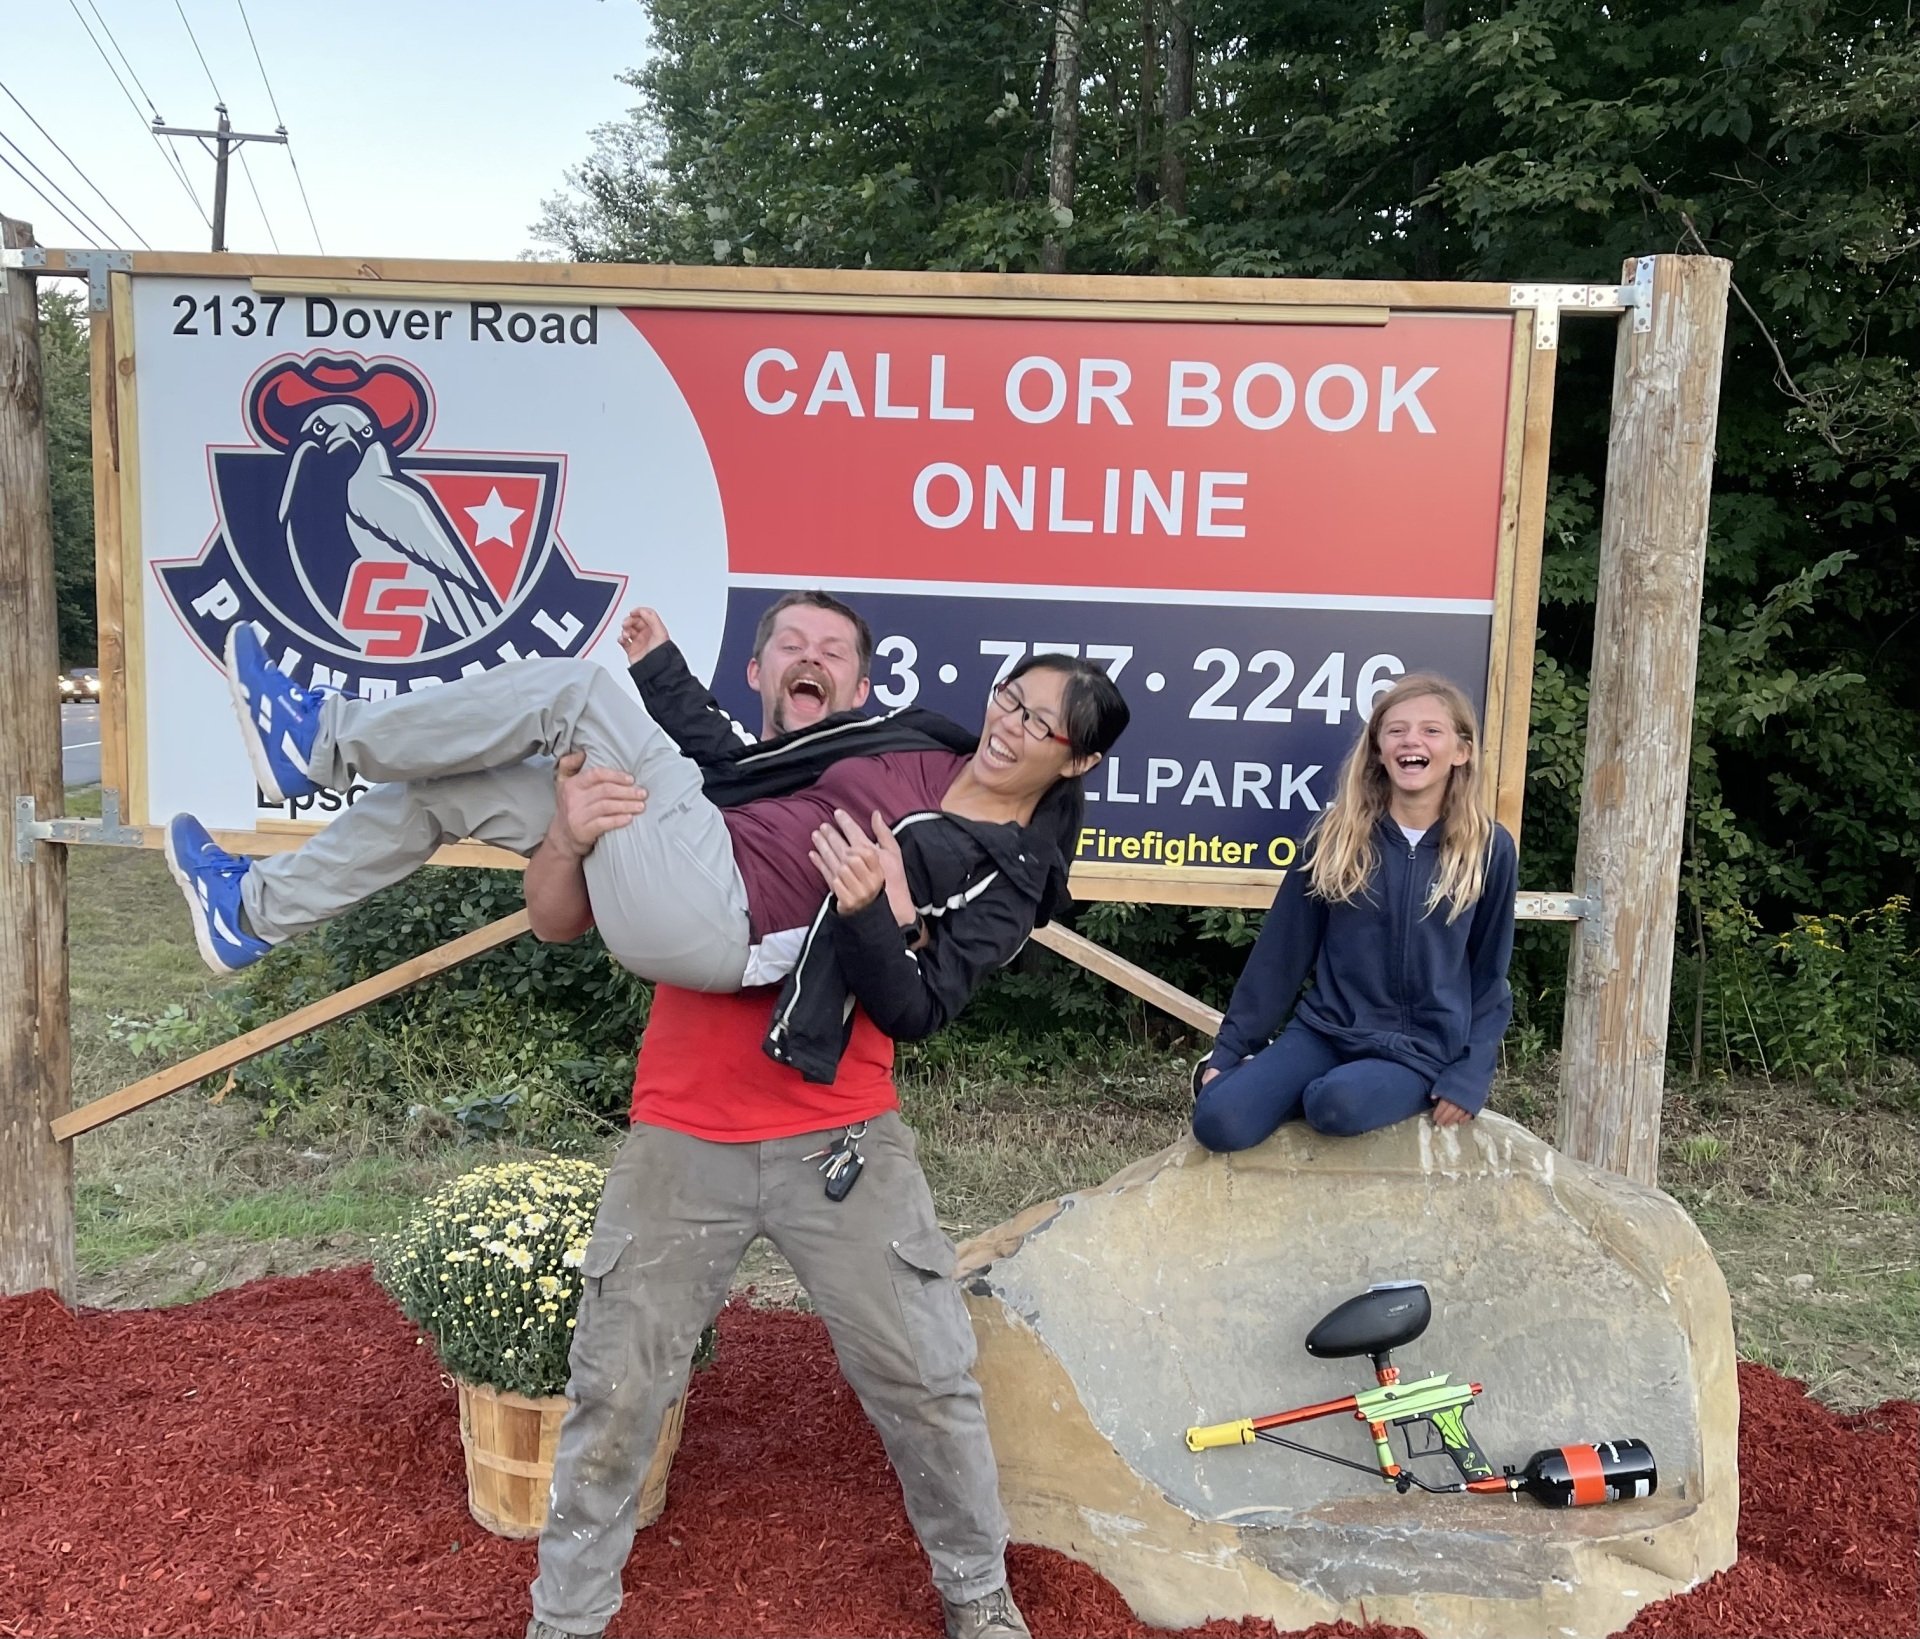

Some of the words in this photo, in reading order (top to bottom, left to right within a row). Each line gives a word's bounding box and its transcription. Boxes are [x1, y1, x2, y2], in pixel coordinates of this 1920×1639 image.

[173, 295, 286, 337] 2137
[305, 297, 452, 340] Dover
[470, 301, 598, 345] Road
[744, 348, 975, 421] CALL
[1006, 356, 1134, 426] OR
[1166, 360, 1440, 434] BOOK
[912, 462, 1249, 538] ONLINE
[980, 640, 1134, 709] 77
[1188, 647, 1406, 725] 2246
[1075, 827, 1258, 867] Firefighter
[1268, 836, 1296, 866] O
